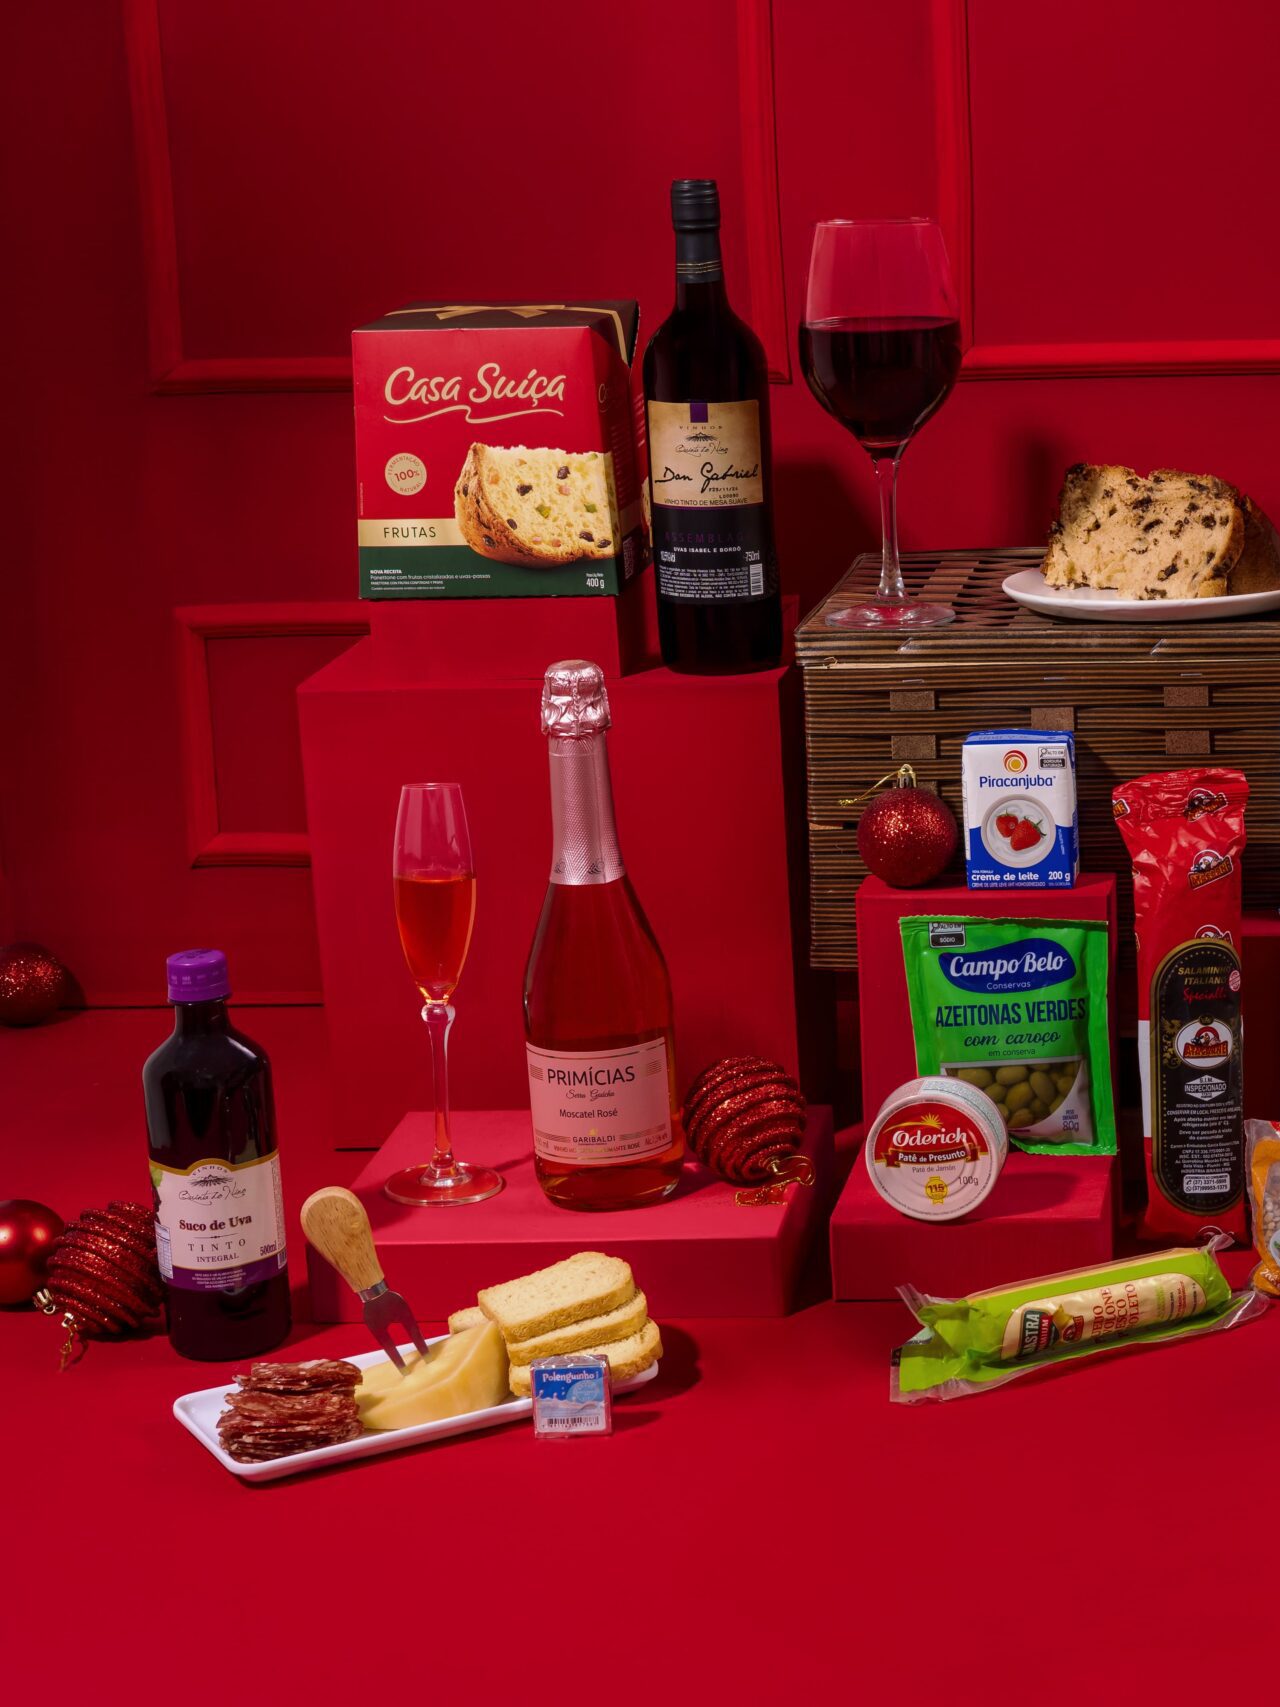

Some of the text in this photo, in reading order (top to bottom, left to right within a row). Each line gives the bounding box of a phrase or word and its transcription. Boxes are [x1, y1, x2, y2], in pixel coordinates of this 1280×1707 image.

[385, 363, 566, 407] Casa Suíça
[394, 469, 420, 482] 100%
[701, 462, 759, 493] Gabriel
[384, 527, 436, 538] FRUTAS
[980, 774, 1053, 789] Piracanjuba
[1019, 872, 1039, 880] leite
[1049, 871, 1071, 881] 200 g
[950, 952, 1067, 981] Campo Belo
[987, 981, 1031, 990] Conservas
[936, 998, 1086, 1028] AZEITONAS VERDES
[964, 1031, 1061, 1048] com caroço
[989, 1048, 1036, 1057] em conserva
[548, 1066, 635, 1086] PRIMÍCIAS
[1184, 1084, 1226, 1092] INSPECIONADO
[560, 1108, 618, 1118] Moscatel Rosé
[892, 1127, 967, 1147] Oderich
[898, 1153, 917, 1162] Patê
[929, 1150, 966, 1162] Presunto
[927, 1183, 945, 1192] 115
[179, 1214, 252, 1231] Suco de Uva
[188, 1239, 246, 1252] TINTO
[197, 1253, 239, 1263] INTEGRAL
[543, 1370, 595, 1383] Polenguinho
